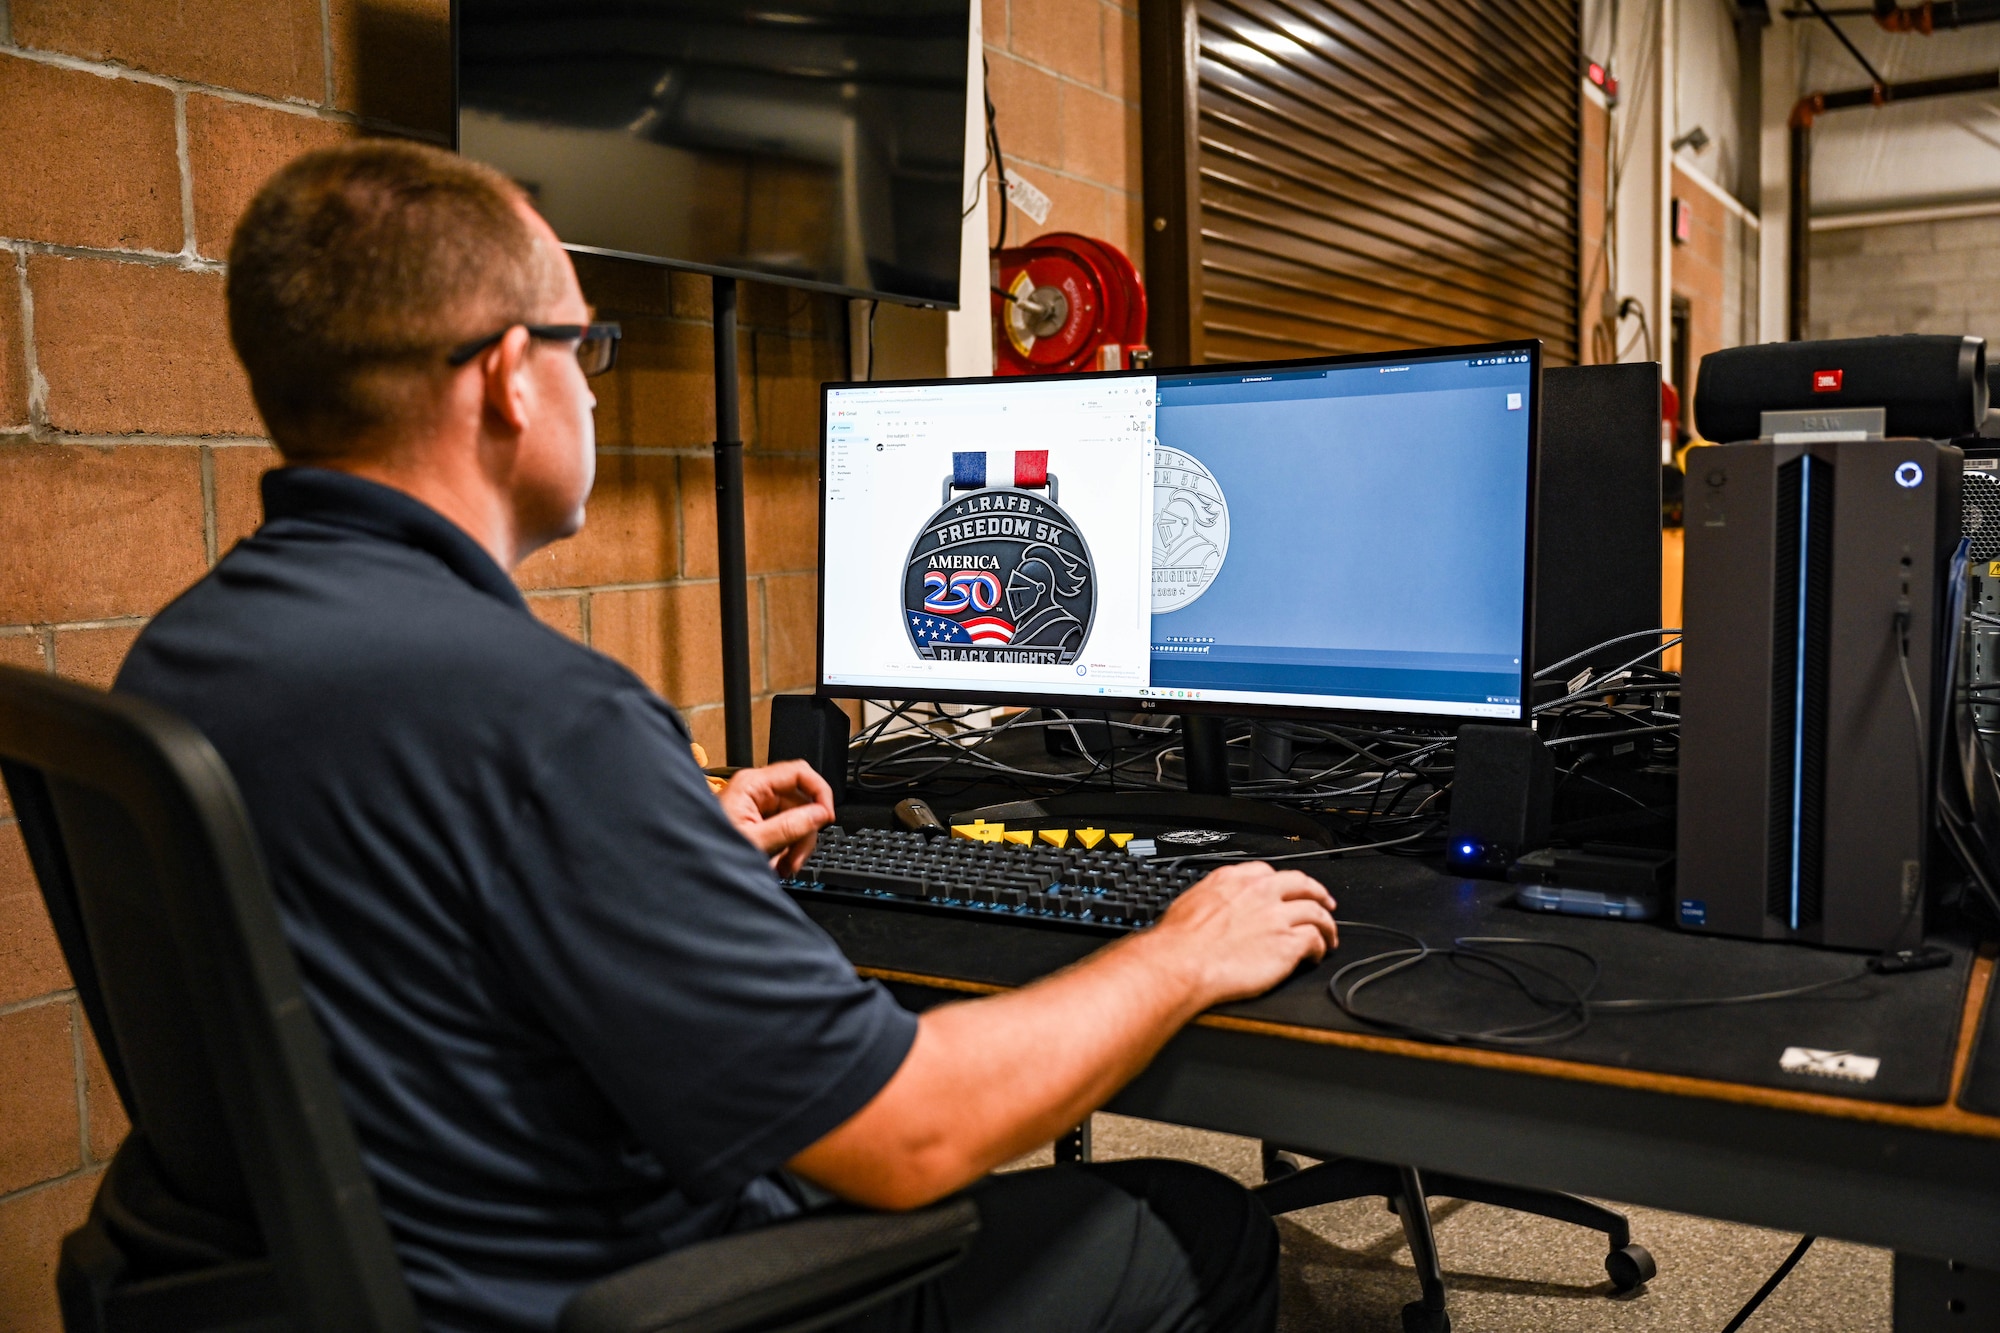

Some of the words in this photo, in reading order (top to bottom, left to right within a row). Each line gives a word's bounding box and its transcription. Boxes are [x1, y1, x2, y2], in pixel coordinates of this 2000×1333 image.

[1180, 473, 1200, 489] 5K
[967, 495, 1031, 513] LRAFB
[937, 517, 1032, 545] FREEDOM
[1035, 522, 1063, 546] 5K
[927, 555, 1001, 570] AMERICA
[924, 570, 1002, 615] 250
[1157, 587, 1178, 597] 2026
[940, 648, 988, 662] BLACK
[993, 650, 1056, 665] KNIGHTS
